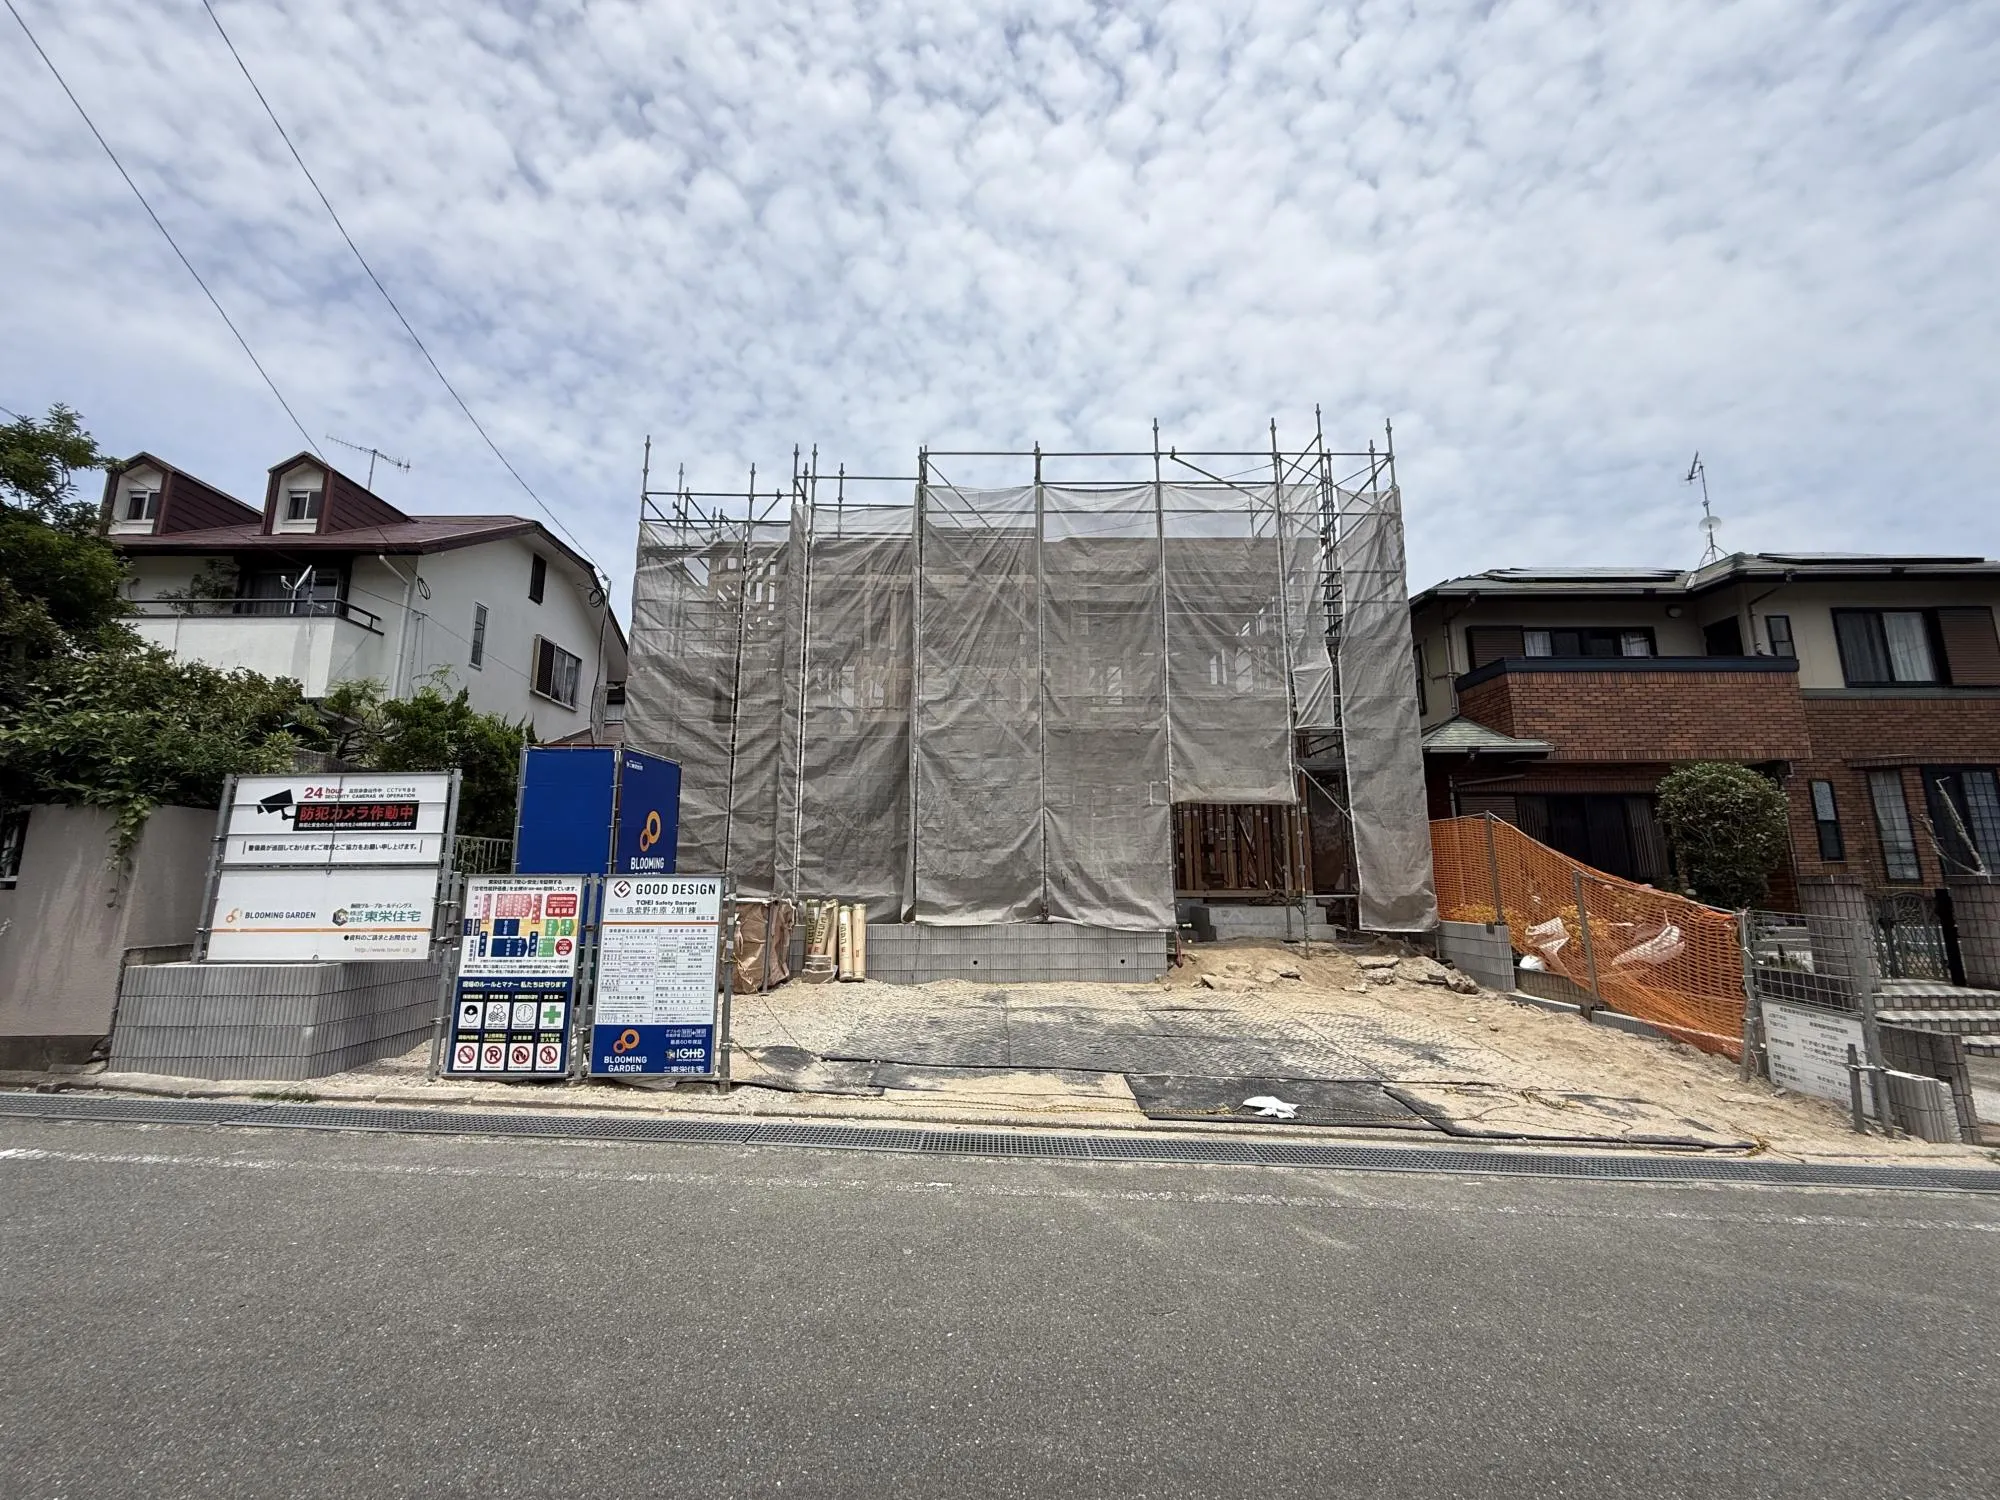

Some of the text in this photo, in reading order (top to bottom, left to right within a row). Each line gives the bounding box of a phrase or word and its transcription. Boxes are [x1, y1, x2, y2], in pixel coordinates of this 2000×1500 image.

[304, 787, 323, 799] 24
[300, 806, 413, 820] 防犯カメラ作動中
[630, 857, 665, 870] BLOOMING
[636, 884, 716, 895] GOOD DESIGN
[364, 910, 421, 922] 東栄住宅
[676, 1048, 705, 1058] IGHD
[603, 1056, 648, 1064] BLOOMING
[608, 1064, 642, 1072] GARDEN
